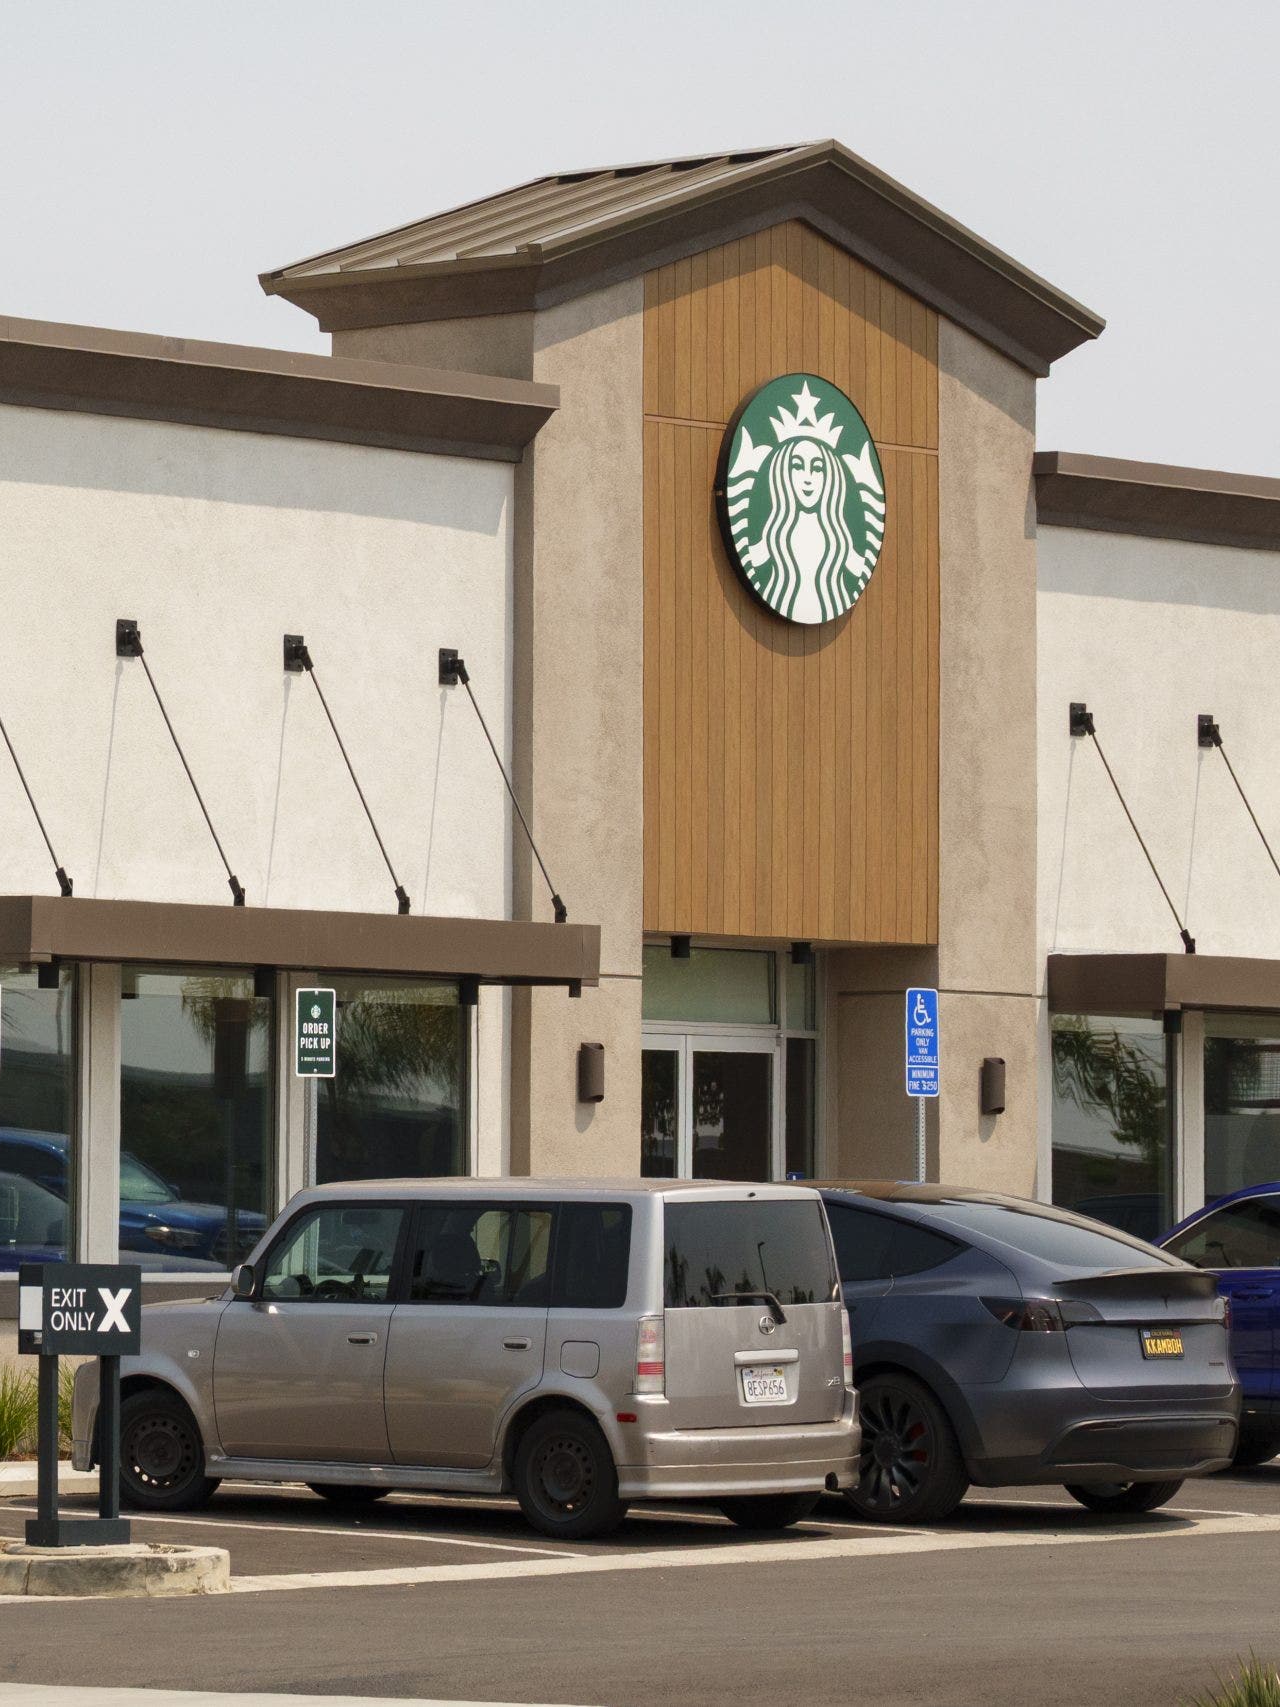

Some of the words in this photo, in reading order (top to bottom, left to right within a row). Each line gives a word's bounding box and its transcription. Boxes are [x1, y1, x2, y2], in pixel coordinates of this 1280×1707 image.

[302, 1022, 329, 1035] ORDER
[910, 1028, 934, 1037] PARKING
[300, 1037, 319, 1049] PICK
[320, 1037, 331, 1049] UP
[915, 1037, 930, 1047] ONLY
[918, 1047, 928, 1055] VAN
[908, 1055, 938, 1064] ACCESSIBLE
[911, 1069, 935, 1079] MINIMUM
[908, 1080, 920, 1091] FINE
[51, 1288, 87, 1308] EXIT
[97, 1287, 133, 1333] X
[50, 1310, 95, 1332] ONLY
[1145, 1338, 1183, 1354] KKAMBOH
[747, 1379, 785, 1397] 8ESP656
